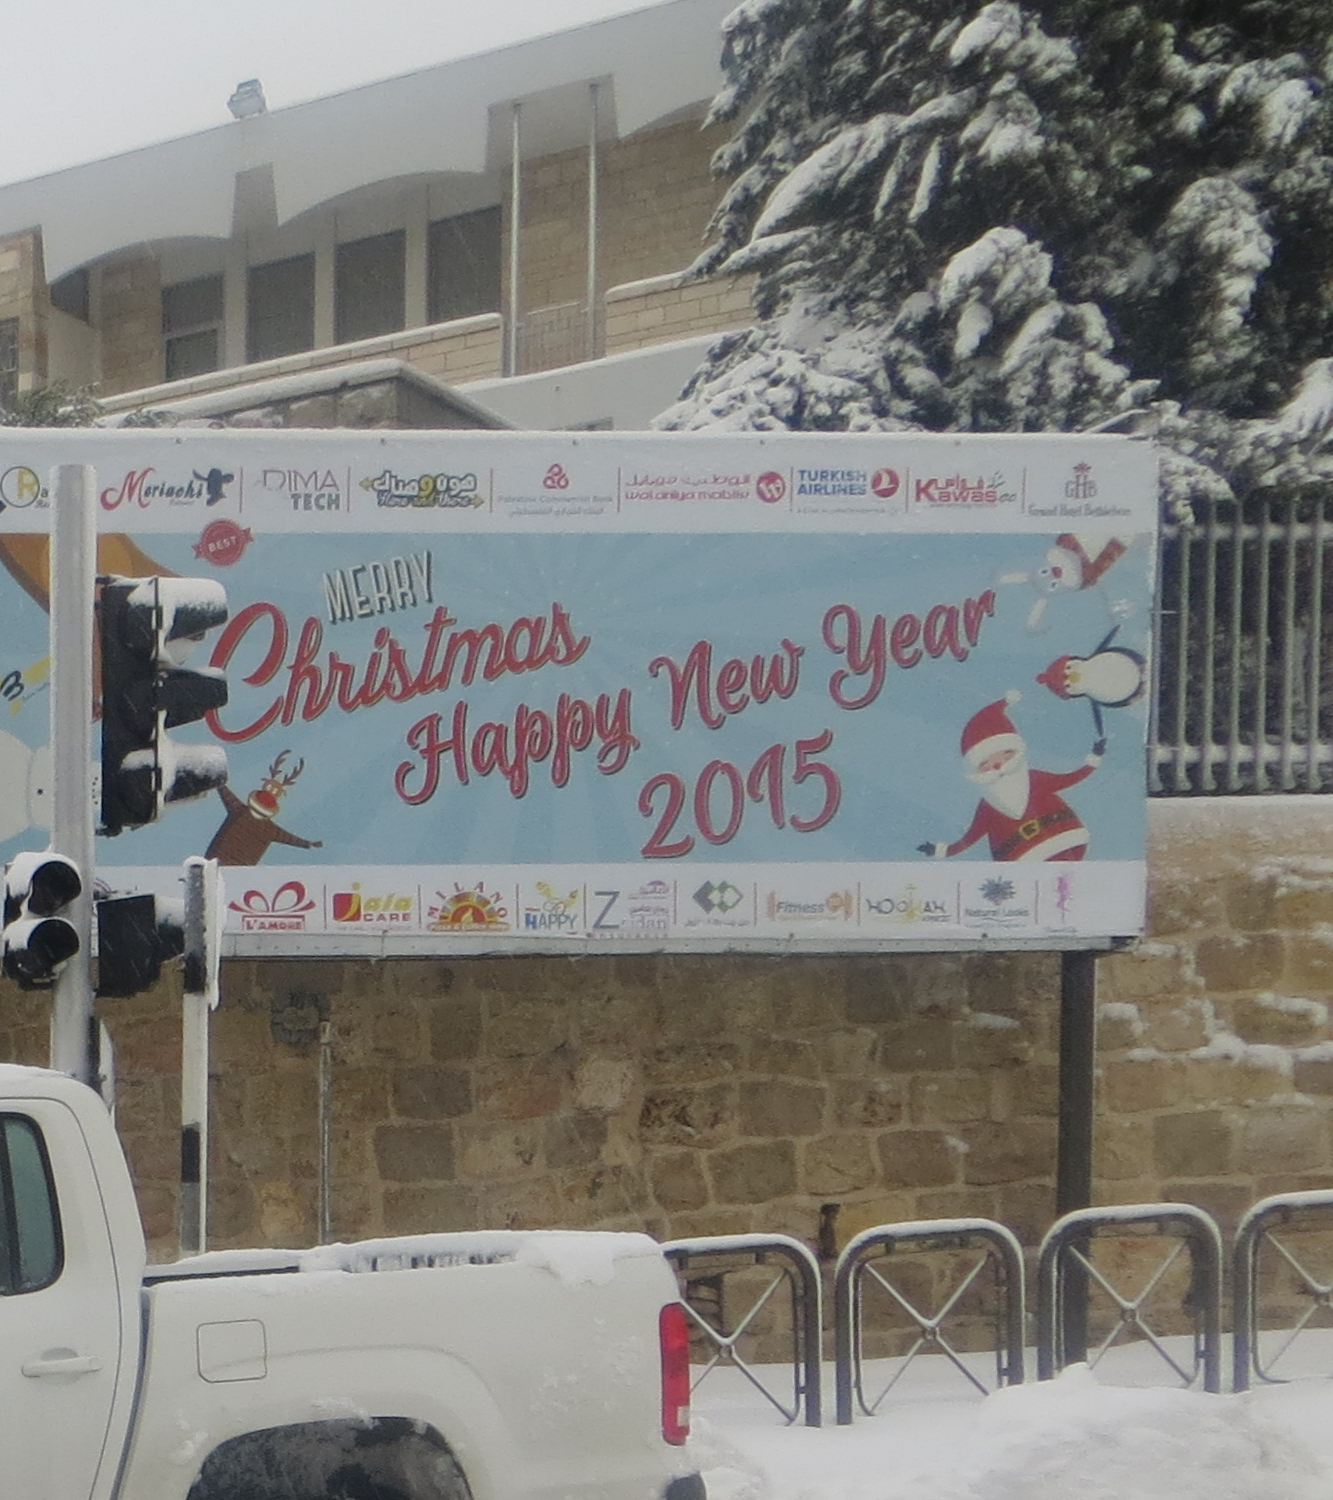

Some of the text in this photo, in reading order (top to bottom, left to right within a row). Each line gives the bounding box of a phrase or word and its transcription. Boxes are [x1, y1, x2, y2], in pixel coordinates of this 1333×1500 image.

[797, 469, 867, 482] TURKISH
[797, 484, 867, 496] AIRLINES
[915, 478, 997, 503] Kawas
[290, 493, 341, 511] TECH
[207, 536, 238, 553] BEST
[322, 549, 434, 625] MERRY
[205, 601, 591, 743] Christmas
[393, 589, 998, 805] Happy New Year
[636, 728, 842, 861] 2015
[363, 913, 412, 923] CARE
[525, 912, 579, 931] HAPPY
